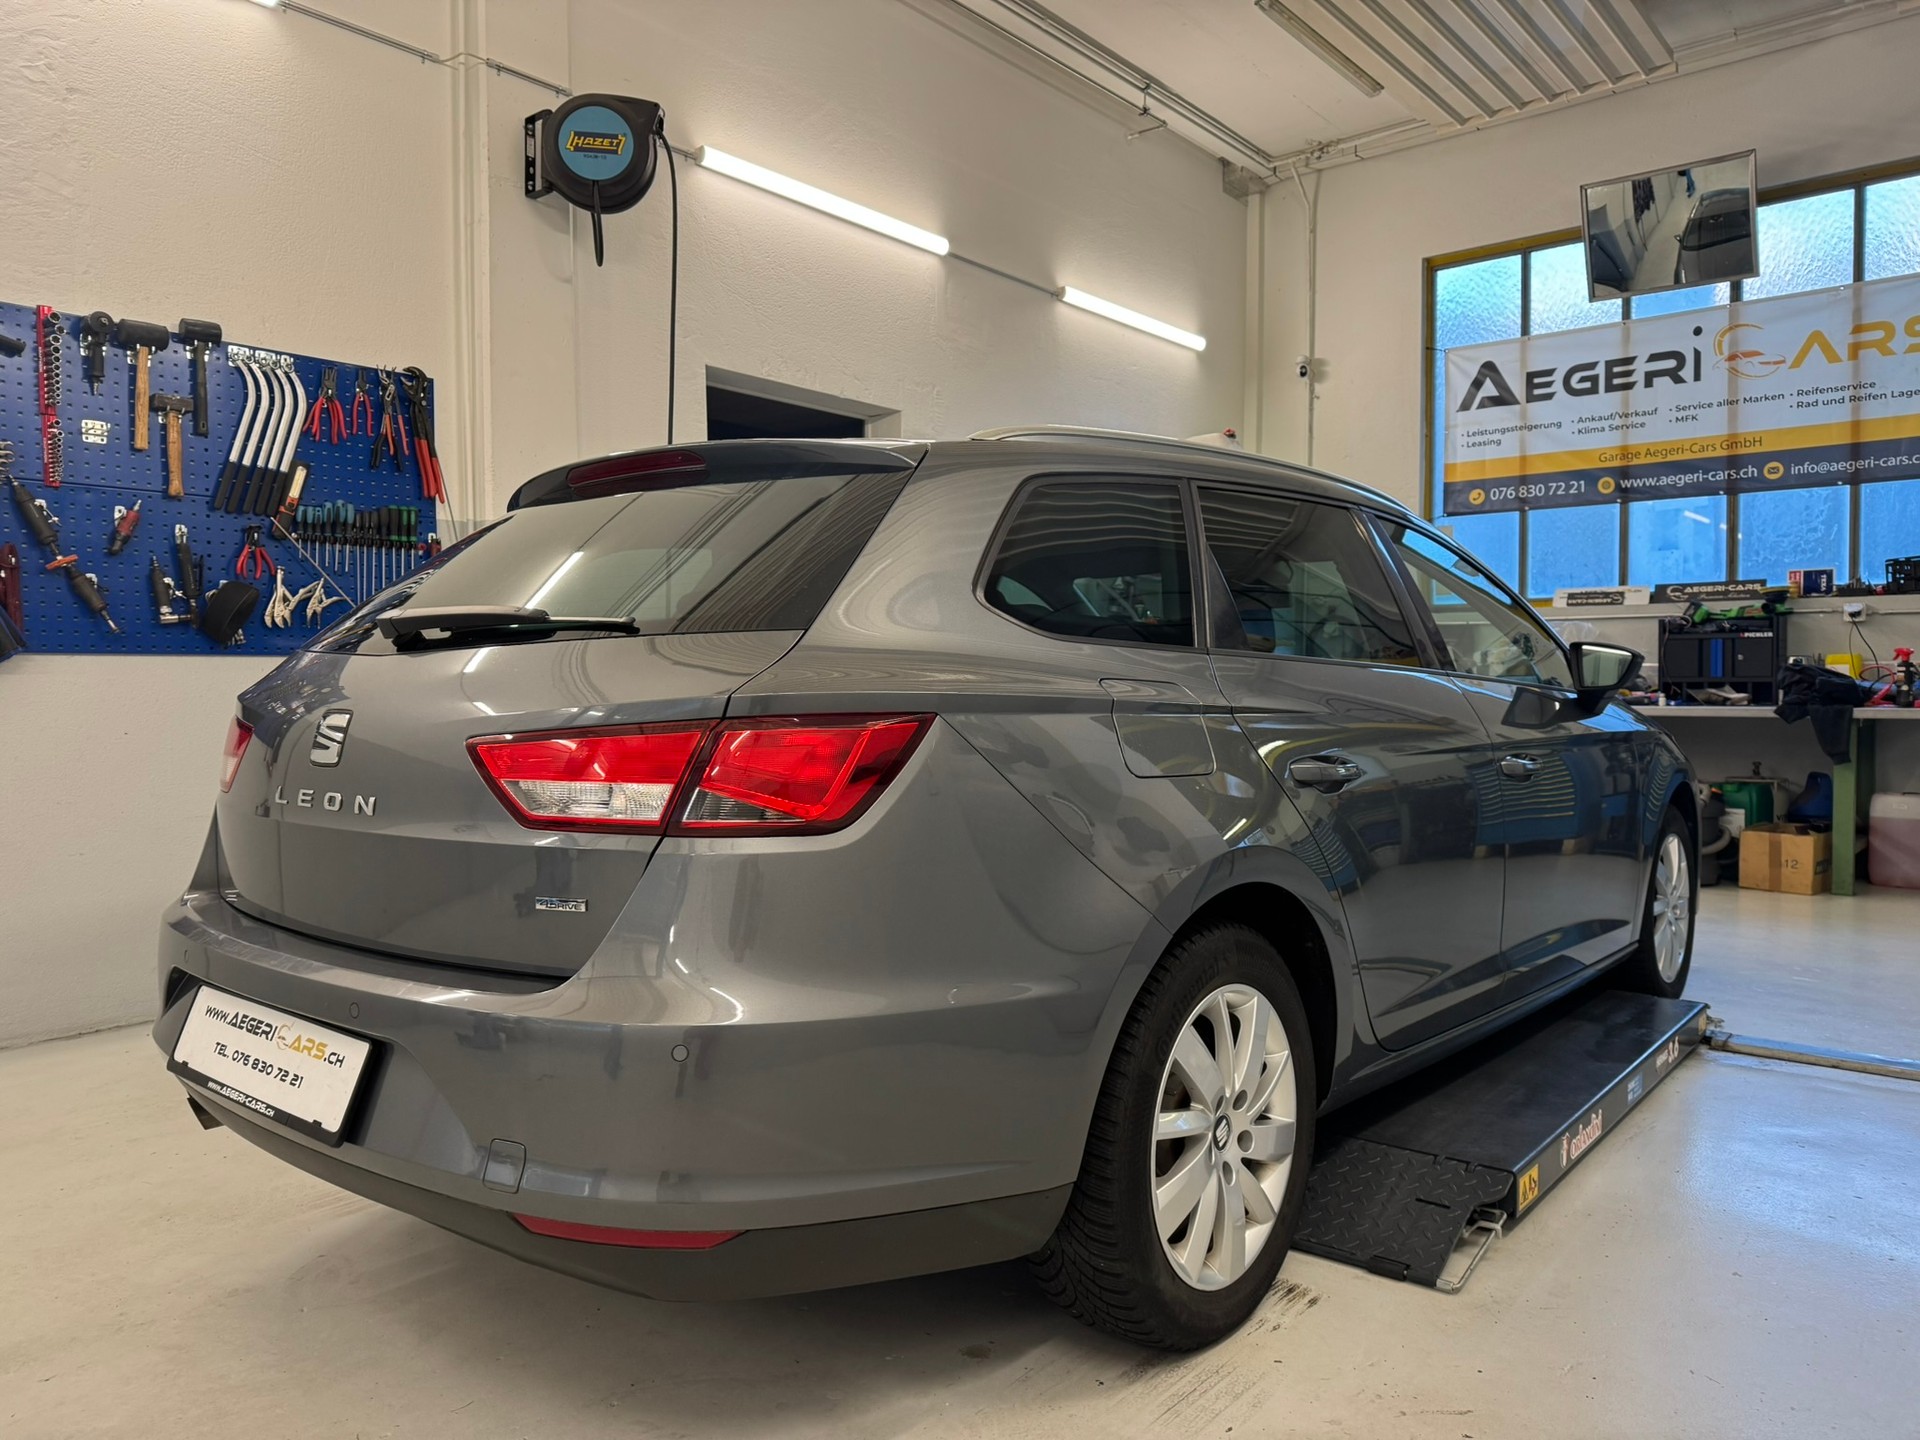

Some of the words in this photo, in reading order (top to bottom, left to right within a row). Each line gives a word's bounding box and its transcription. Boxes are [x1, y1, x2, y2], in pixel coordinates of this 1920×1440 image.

[572, 135, 620, 147] HAZET
[1796, 380, 1877, 397] Reifenservice
[1675, 400, 1714, 412] Service
[1716, 398, 1740, 408] aller
[1743, 392, 1785, 404] Marken
[1796, 399, 1819, 409] Rad
[1822, 395, 1845, 407] und
[1849, 390, 1887, 403] Reifen
[1577, 407, 1659, 424] Ankauf/Verkauf
[1675, 414, 1699, 424] MFK
[1467, 420, 1562, 438] Leistungssteigerung
[1577, 426, 1605, 436] Klima
[1608, 421, 1646, 432] Service
[1467, 438, 1502, 448] Leasing
[1598, 450, 1642, 464] Garage
[1643, 440, 1717, 461] Aegeri-Cars
[1720, 436, 1763, 451] GmbH
[1620, 464, 1758, 489] www.aegeri-cars.ch
[1490, 487, 1516, 500] 076
[1518, 484, 1545, 498] 830
[1548, 482, 1566, 496] 72
[1569, 480, 1586, 494] 21
[275, 785, 376, 816] LEON
[1784, 859, 1799, 870] 12
[213, 1041, 229, 1059] TEL.
[232, 1049, 251, 1067] 076
[251, 1056, 274, 1077] 830
[273, 1066, 290, 1084] 72
[289, 1072, 304, 1089] 21
